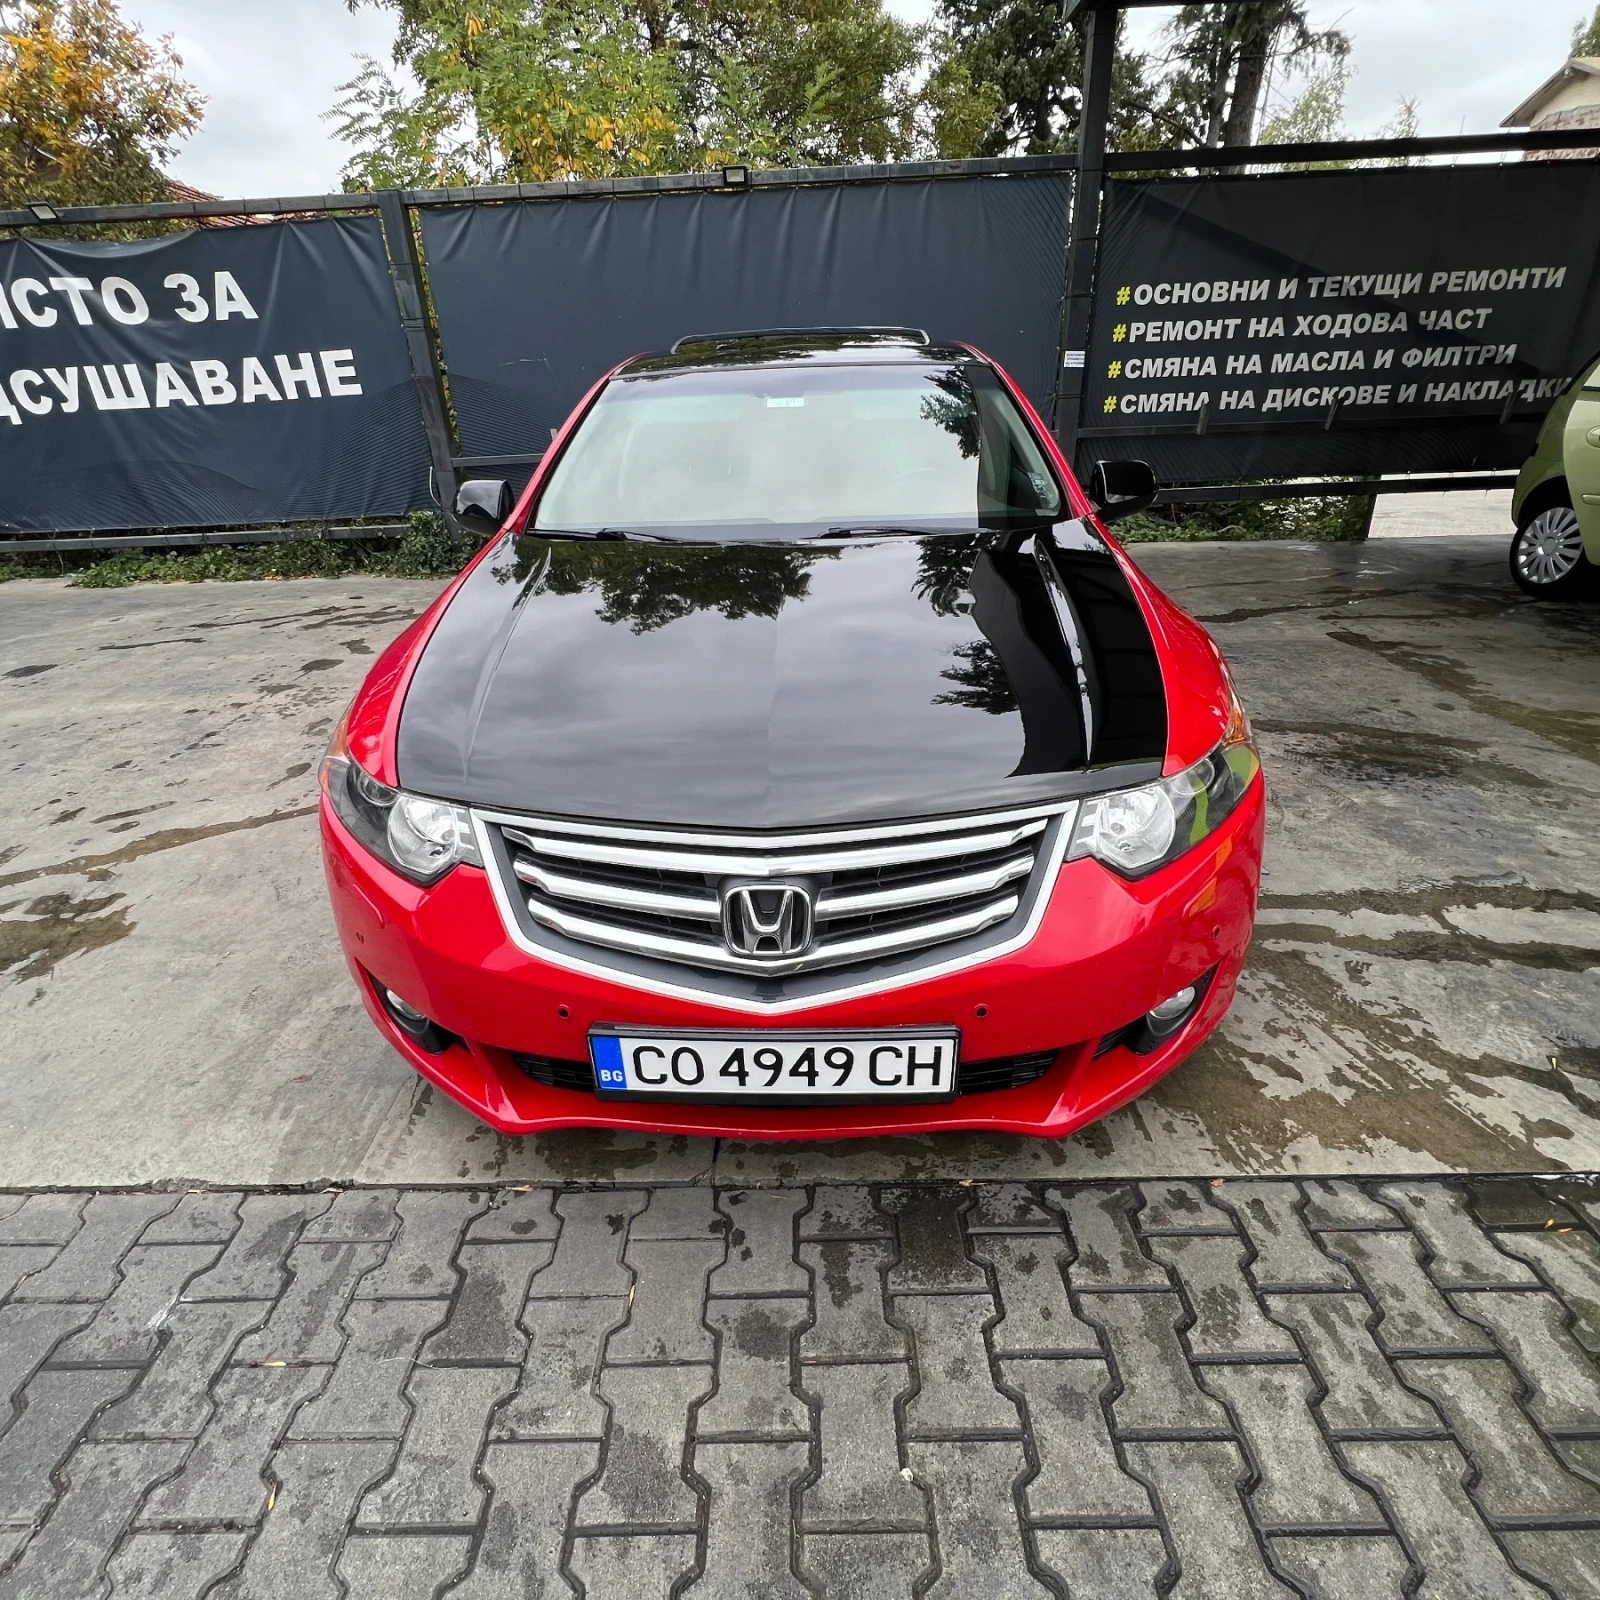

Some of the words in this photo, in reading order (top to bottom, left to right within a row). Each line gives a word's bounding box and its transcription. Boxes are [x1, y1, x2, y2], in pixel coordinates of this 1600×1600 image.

[164, 270, 259, 323] ЗА
[1116, 279, 1270, 306] #ОСНОВНИ
[1278, 278, 1299, 300] И
[1307, 272, 1423, 299] ТЕКУЩИ
[1429, 266, 1567, 293] РЕМОНТИ
[1112, 318, 1242, 343] #РЕМОНТ
[1248, 316, 1285, 339] НА
[1292, 312, 1408, 338] ХОДОВА
[1418, 308, 1492, 331] ЧАСТ
[1107, 354, 1217, 379] #СМЯНА
[1225, 353, 1263, 375] НА
[1270, 349, 1366, 374] МАСЛА
[1373, 348, 1395, 369] И
[1401, 343, 1518, 368] ФИЛТРИ
[1219, 390, 1255, 411] НА
[1261, 384, 1392, 413] ДИСКОВЕ
[1397, 383, 1418, 404] И
[1423, 377, 1573, 403] НАКЛАДКИ
[601, 1069, 624, 1083] BG
[632, 1045, 703, 1086] CO
[719, 1047, 855, 1087] 4949
[869, 1045, 943, 1086] CH
